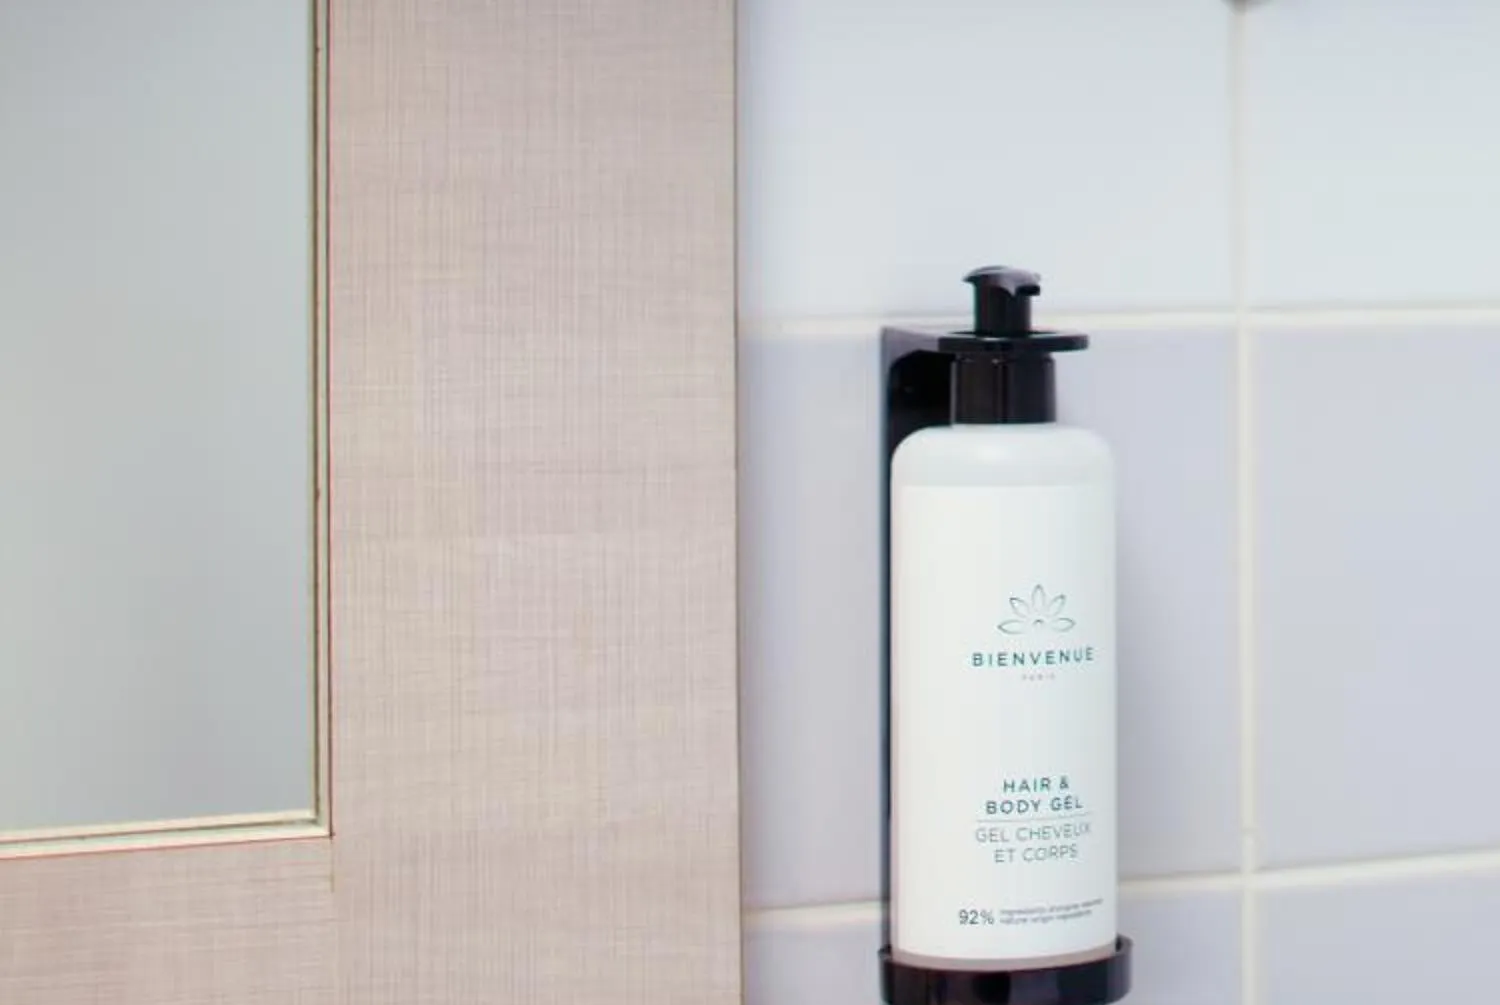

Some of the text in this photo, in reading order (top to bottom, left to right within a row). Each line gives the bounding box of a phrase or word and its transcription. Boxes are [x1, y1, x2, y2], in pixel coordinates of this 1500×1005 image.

[972, 647, 1095, 667] BIENVENUE
[1002, 775, 1070, 793] HAIR &
[985, 796, 1083, 815] BODY GEL
[975, 823, 1091, 843] GEL CHEVEUX
[993, 843, 1078, 863] ET CORPS
[958, 909, 995, 925] 92%
